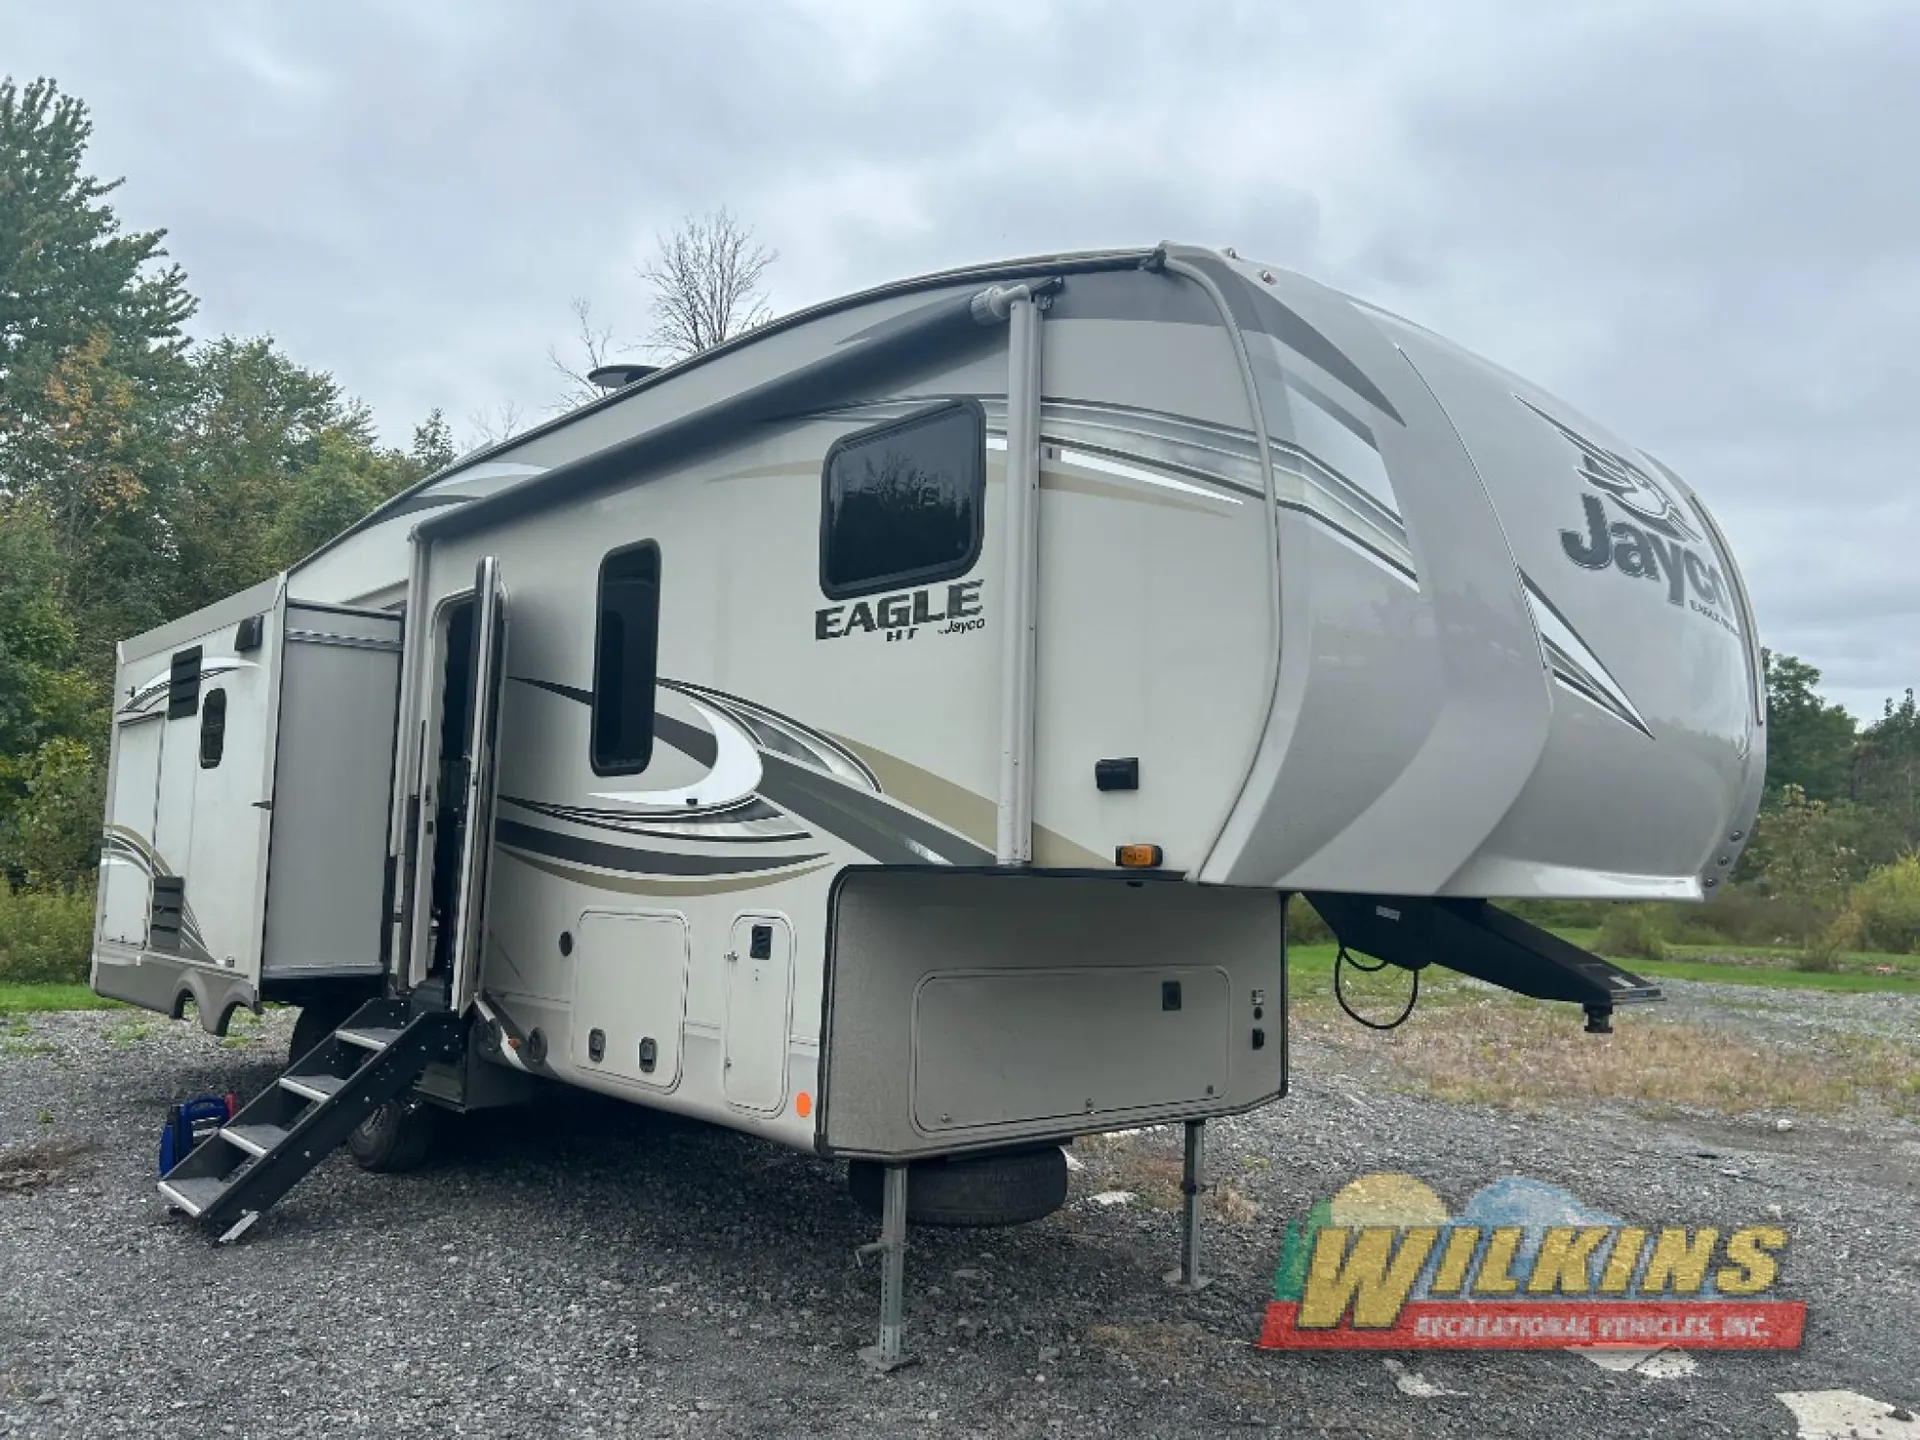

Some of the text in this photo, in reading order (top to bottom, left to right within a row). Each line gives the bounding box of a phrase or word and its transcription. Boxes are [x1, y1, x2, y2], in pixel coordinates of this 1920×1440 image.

[815, 579, 984, 641] EAGLE
[886, 628, 919, 642] HT
[944, 617, 985, 635] Jayco
